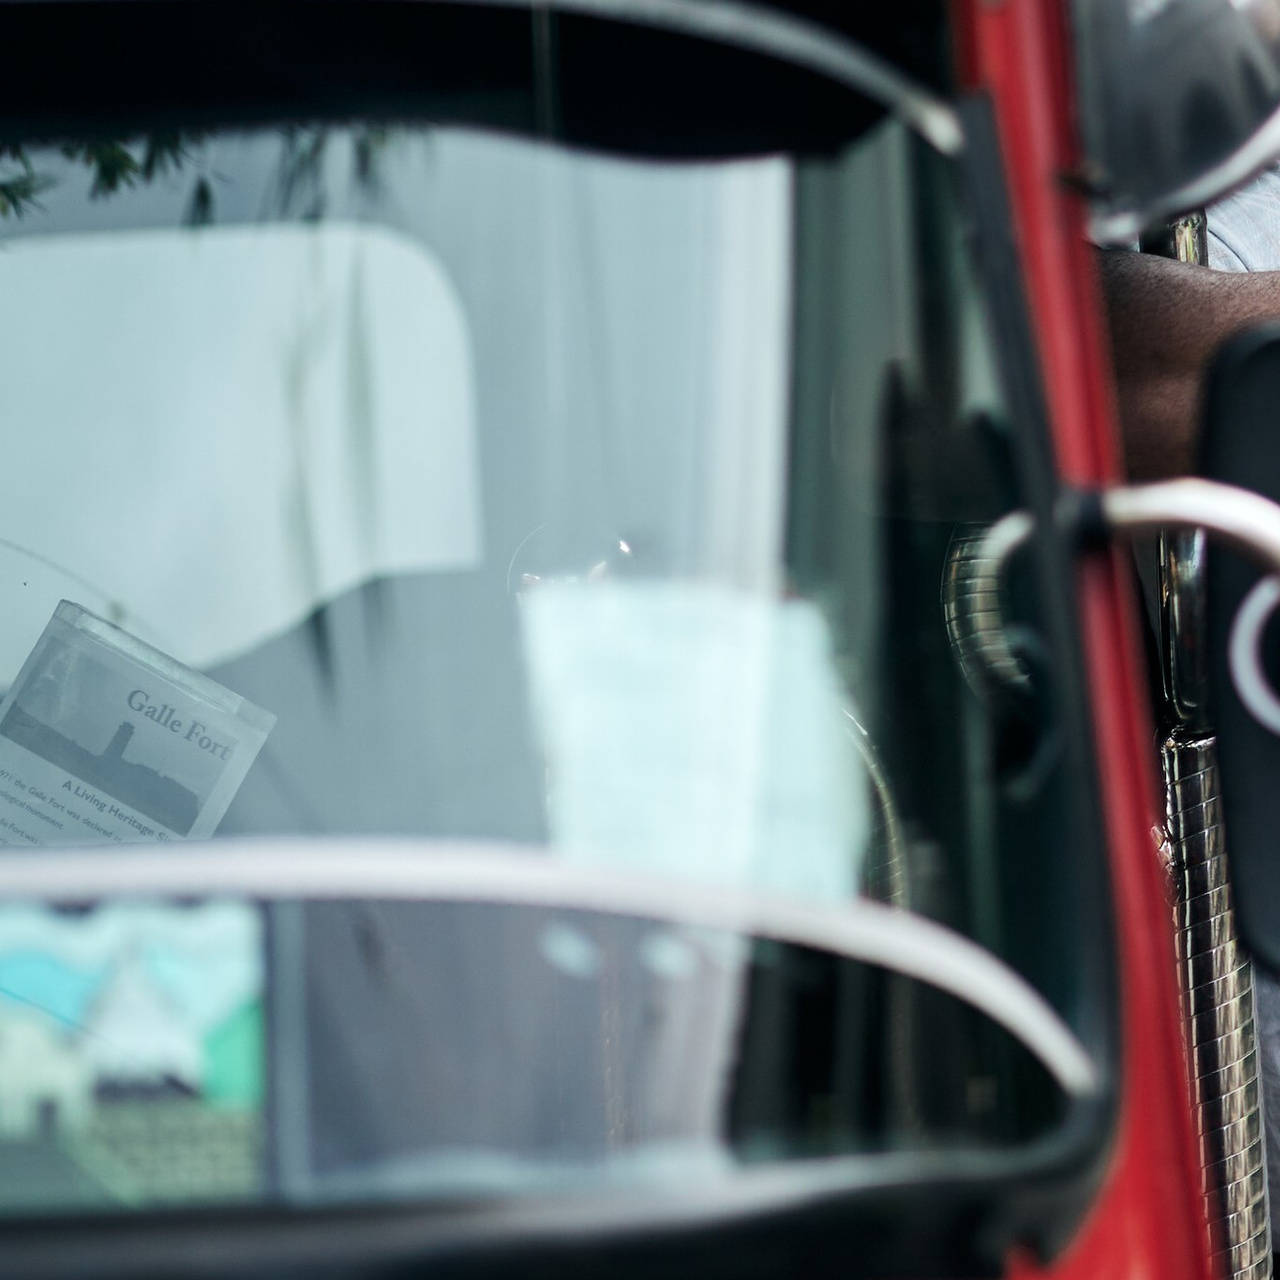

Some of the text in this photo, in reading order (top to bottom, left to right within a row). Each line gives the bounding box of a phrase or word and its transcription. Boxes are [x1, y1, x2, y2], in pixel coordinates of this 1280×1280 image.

[127, 689, 232, 761] Galle Fort
[48, 797, 66, 812] Fort
[62, 780, 72, 791] A
[74, 786, 107, 813] Living
[108, 805, 155, 837] Heritage
